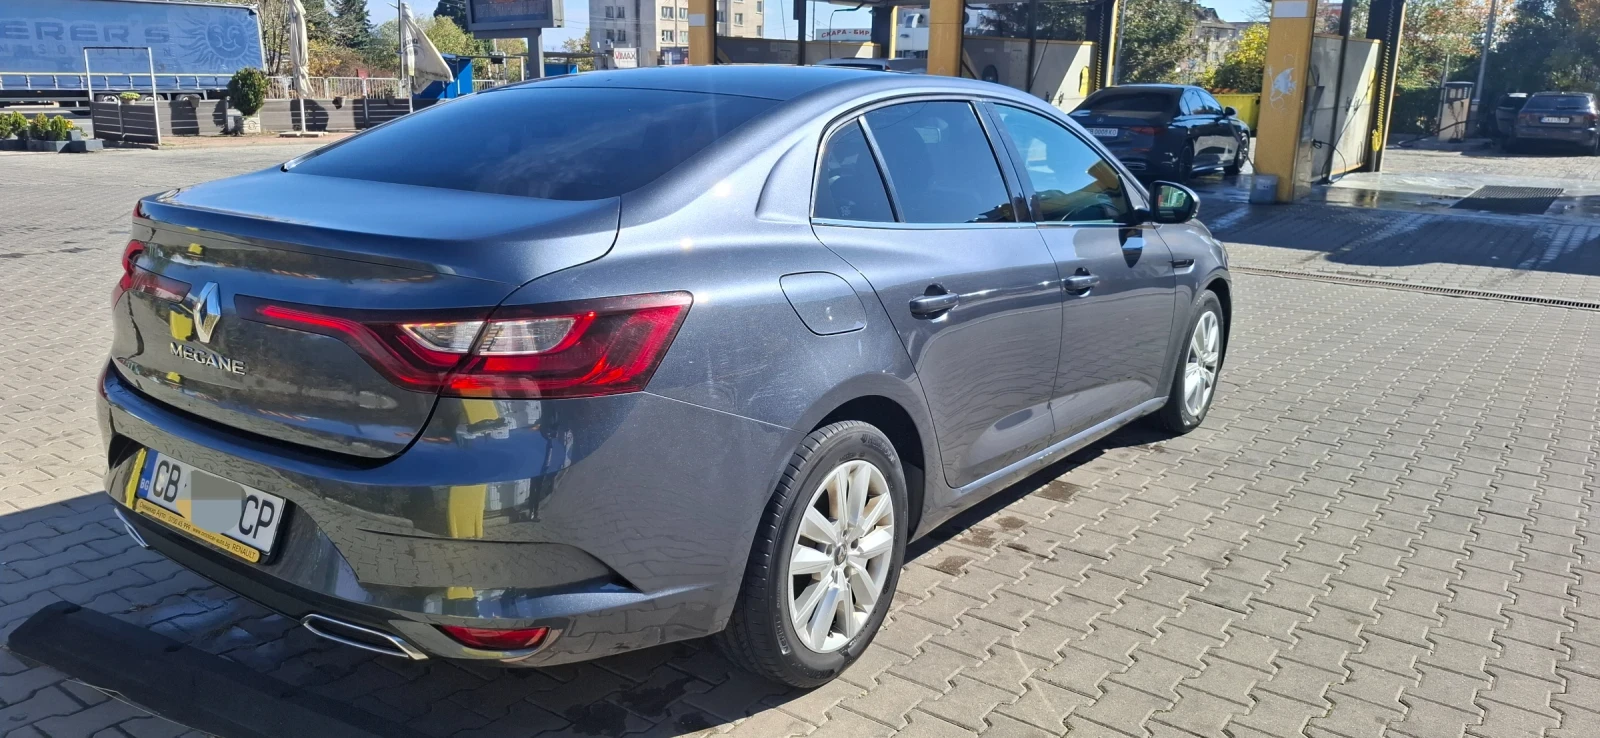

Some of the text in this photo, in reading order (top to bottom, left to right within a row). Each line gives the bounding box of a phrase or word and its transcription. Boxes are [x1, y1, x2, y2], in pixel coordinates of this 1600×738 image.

[853, 29, 873, 37] БИР
[170, 341, 246, 376] MEGANE
[140, 478, 150, 490] BG
[153, 460, 181, 503] CB
[238, 495, 275, 539] CP
[232, 543, 256, 560] RENAULT
